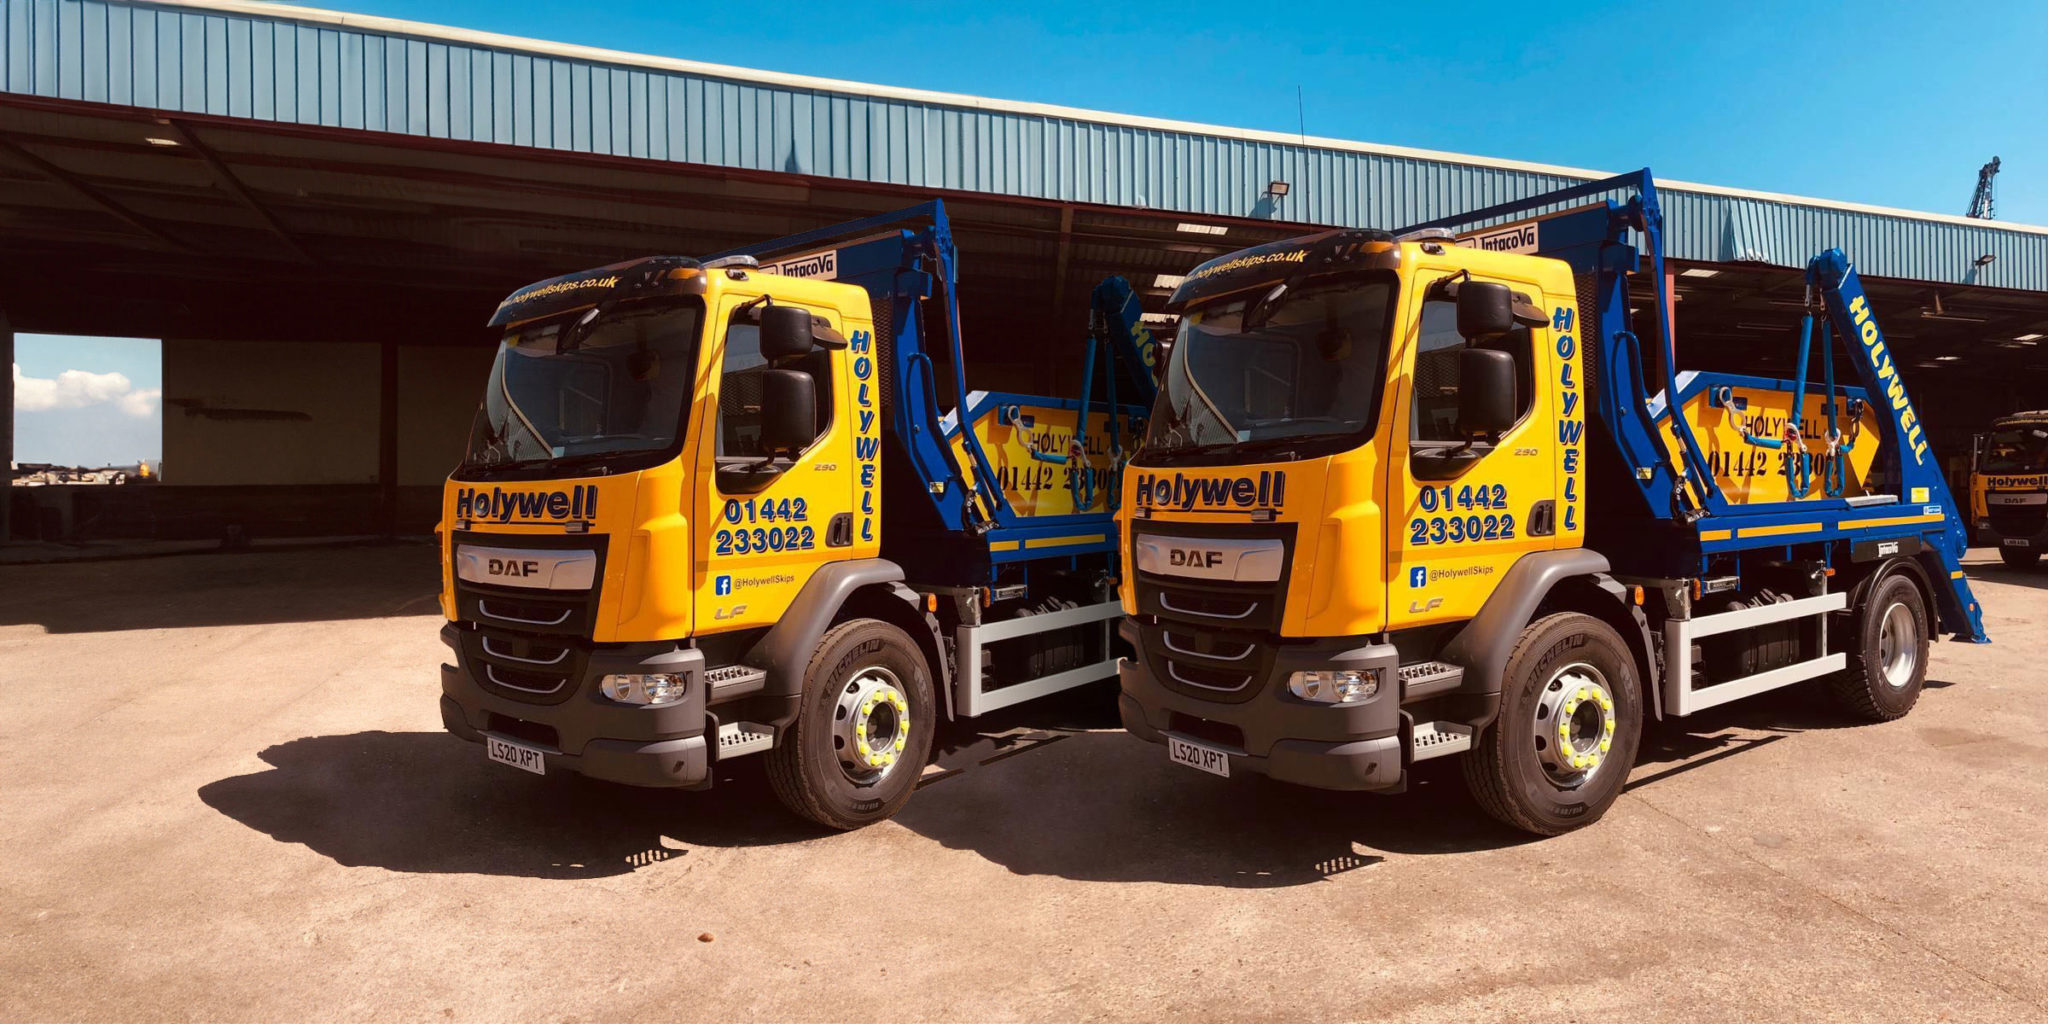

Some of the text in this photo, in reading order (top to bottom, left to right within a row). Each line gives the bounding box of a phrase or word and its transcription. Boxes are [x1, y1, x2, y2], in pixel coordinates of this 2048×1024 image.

[1849, 295, 1927, 466] HOLYWELL
[1553, 306, 1584, 531] HOLYWELL
[850, 330, 880, 541] HOLYWELL
[1514, 448, 1538, 456] 290
[1707, 451, 1767, 477] 01442
[814, 463, 837, 472] 290
[996, 466, 1054, 491] 01442
[456, 485, 598, 525] Holywell
[1137, 470, 1286, 512] Holywell
[1419, 483, 1507, 512] 01442
[724, 497, 808, 524] 01442
[716, 525, 815, 556] 233022
[1410, 513, 1515, 546] 233022
[488, 558, 539, 577] DAF
[1169, 548, 1223, 568] DAF
[734, 574, 795, 590] @HolywellSkips
[1430, 565, 1494, 581] @HolywellSkips
[714, 604, 748, 620] LF
[1408, 598, 1443, 613] LF
[825, 638, 881, 694] MICHELIN
[1526, 633, 1585, 689] MICHELIN
[491, 740, 540, 769] LS20 XPT
[1173, 740, 1224, 772] LS20 XPT
